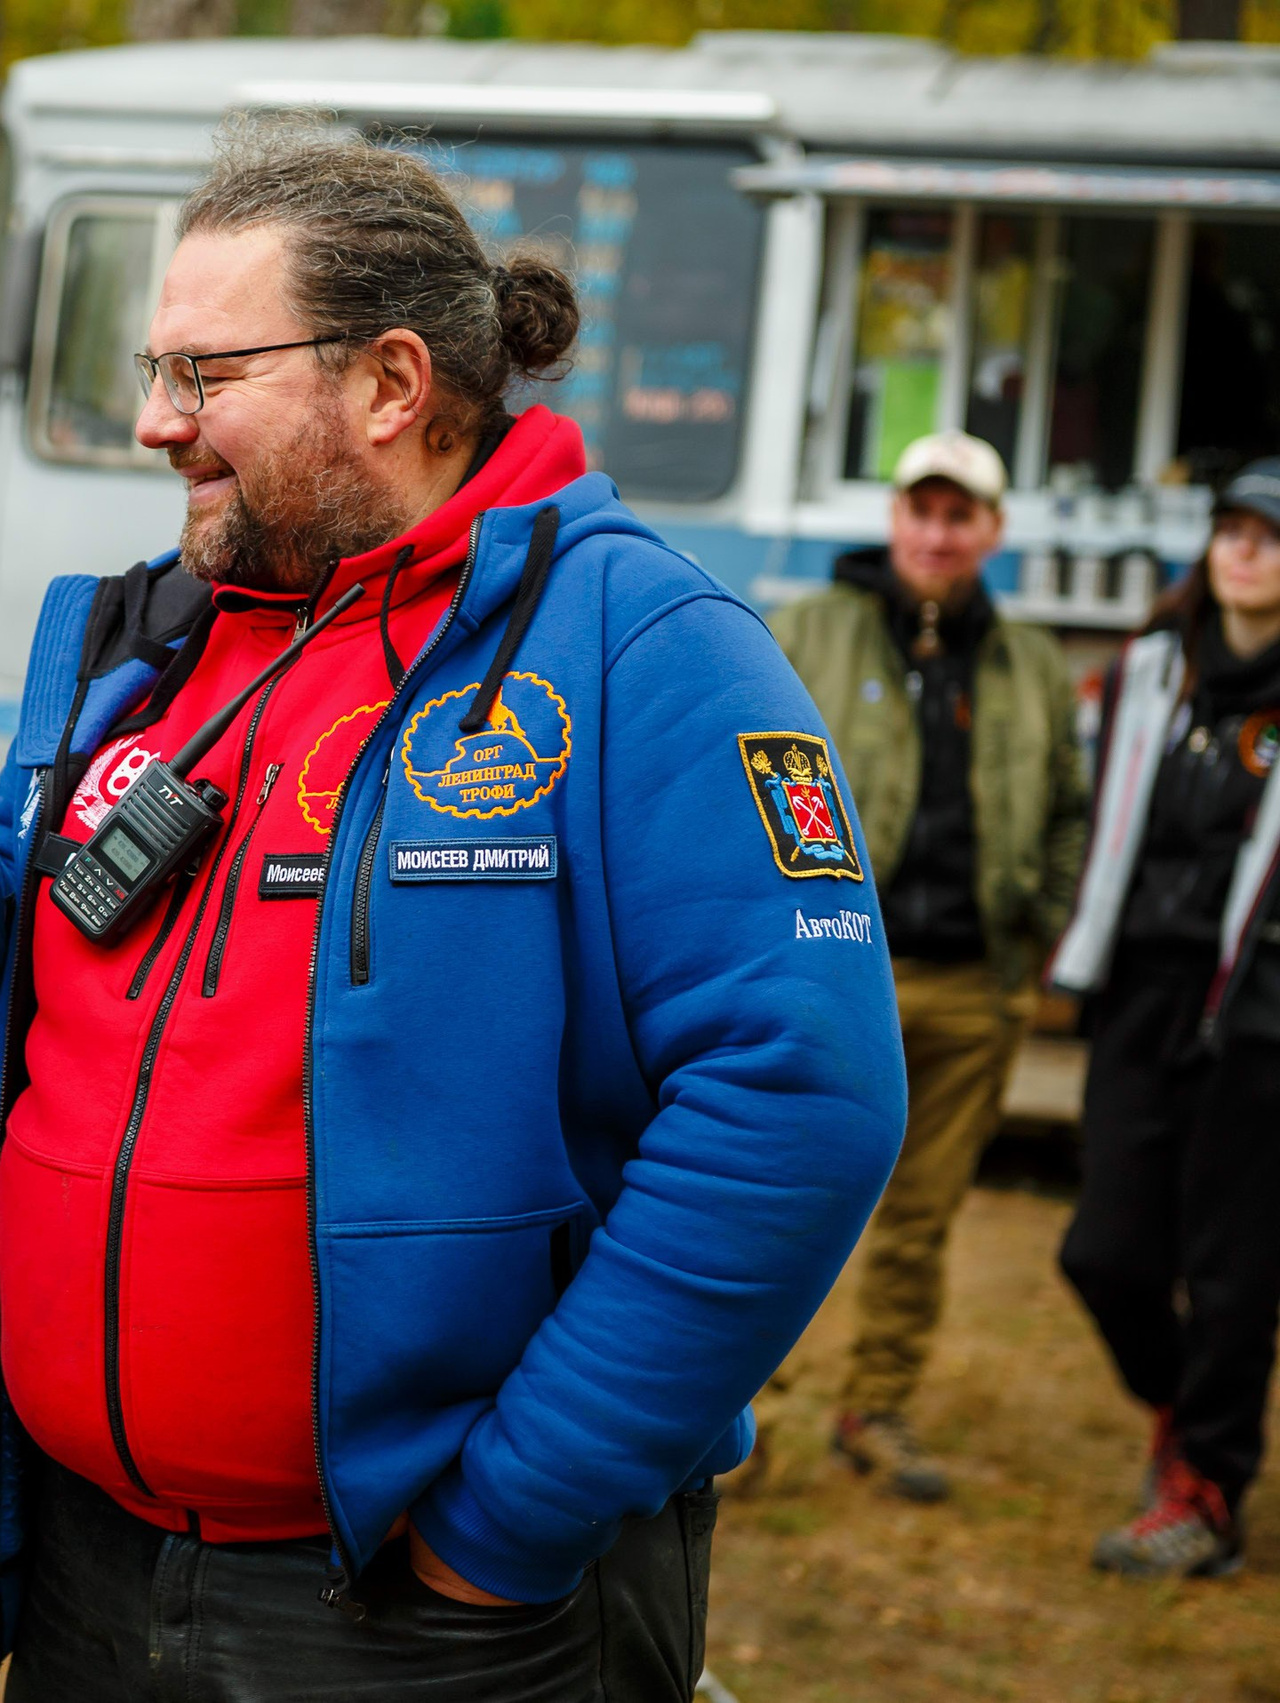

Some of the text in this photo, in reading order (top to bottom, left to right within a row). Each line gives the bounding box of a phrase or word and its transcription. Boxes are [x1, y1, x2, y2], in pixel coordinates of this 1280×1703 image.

[473, 745, 504, 762] ОРГ
[438, 763, 537, 788] ЛЕНИНГРАД
[158, 785, 183, 806] TYT
[459, 783, 516, 803] ТРОФИ
[397, 845, 550, 871] МОИСЕЕВ ДМИТРИЙ
[796, 908, 873, 943] АвтоКОТ
